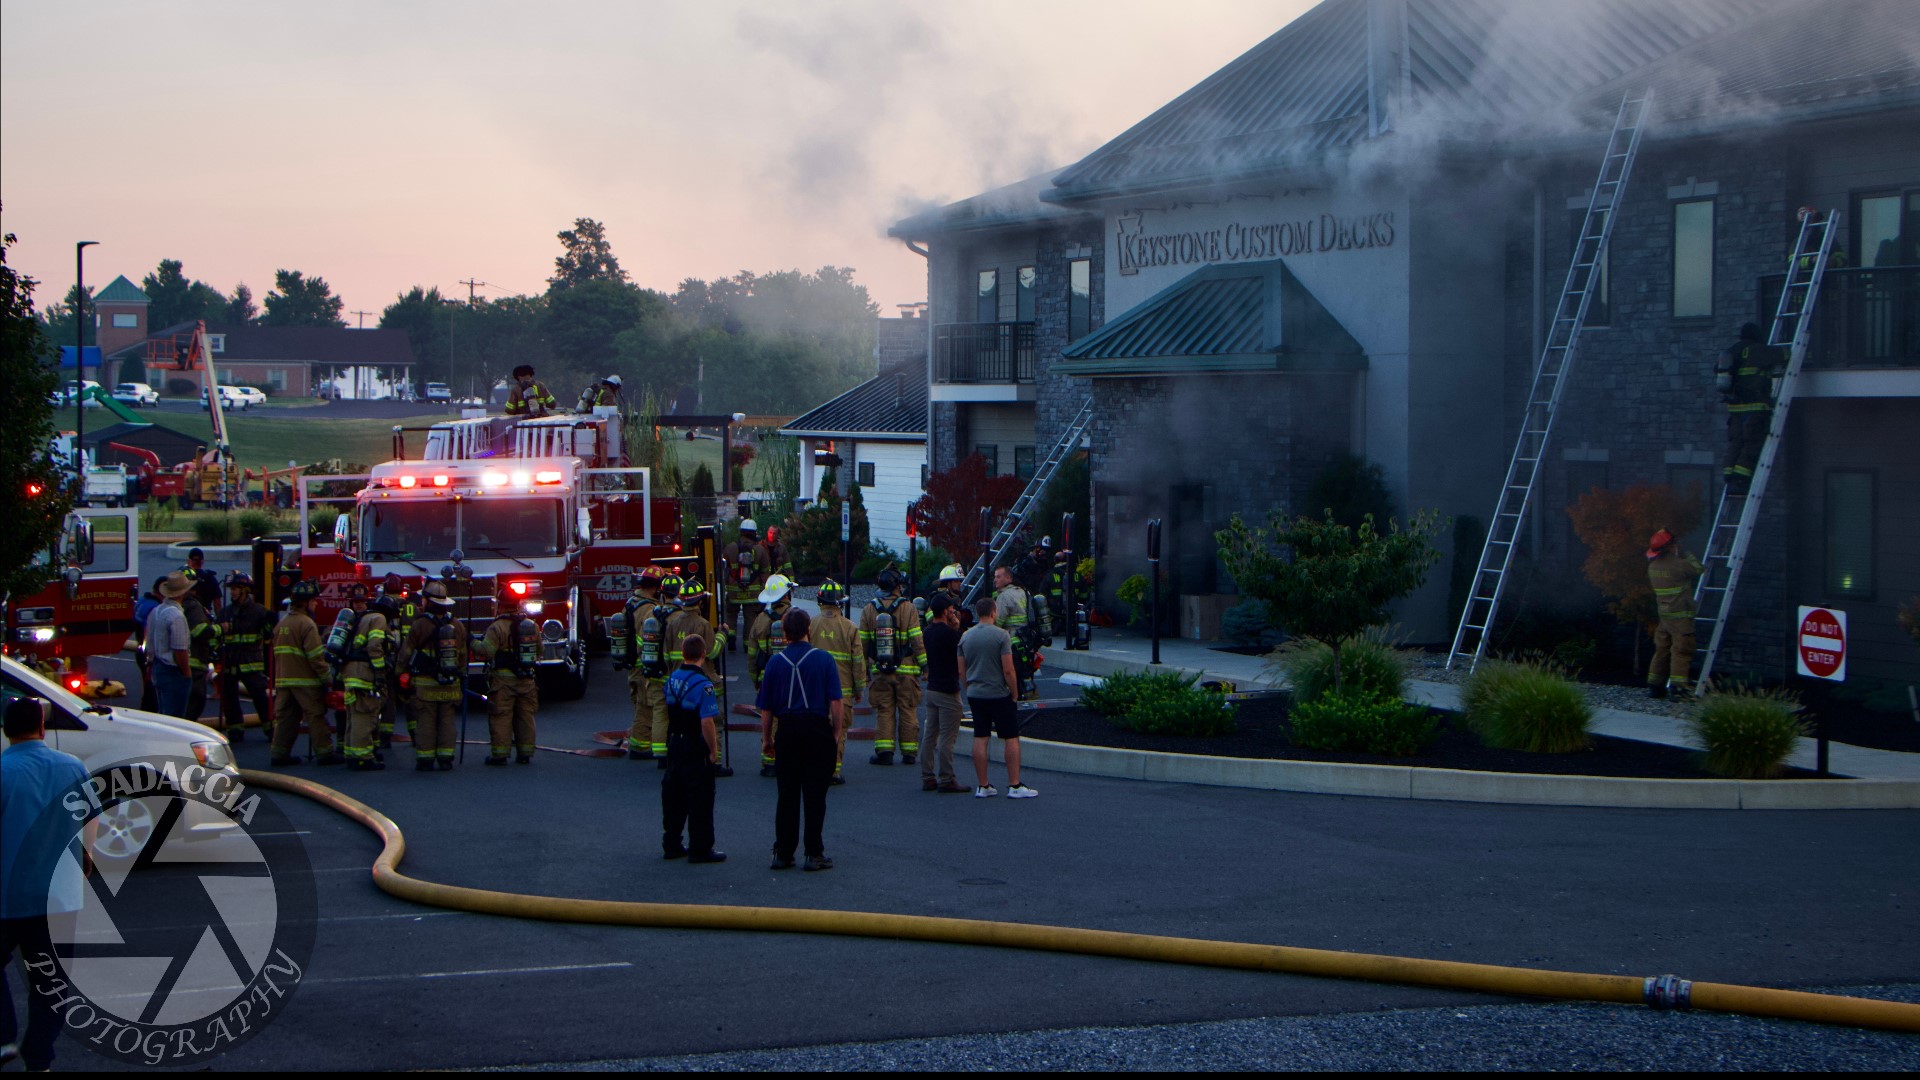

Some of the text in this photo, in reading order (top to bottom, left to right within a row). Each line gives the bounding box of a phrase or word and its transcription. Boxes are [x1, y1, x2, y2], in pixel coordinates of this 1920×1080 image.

[1118, 211, 1396, 270] KEYSTONE CUSTOM DECKS
[594, 564, 634, 574] LADDER
[596, 574, 633, 592] 43
[107, 591, 128, 599] SPOT
[93, 602, 128, 610] RESCUE
[1805, 620, 1839, 635] DO NOT
[1807, 651, 1836, 666] ENTER
